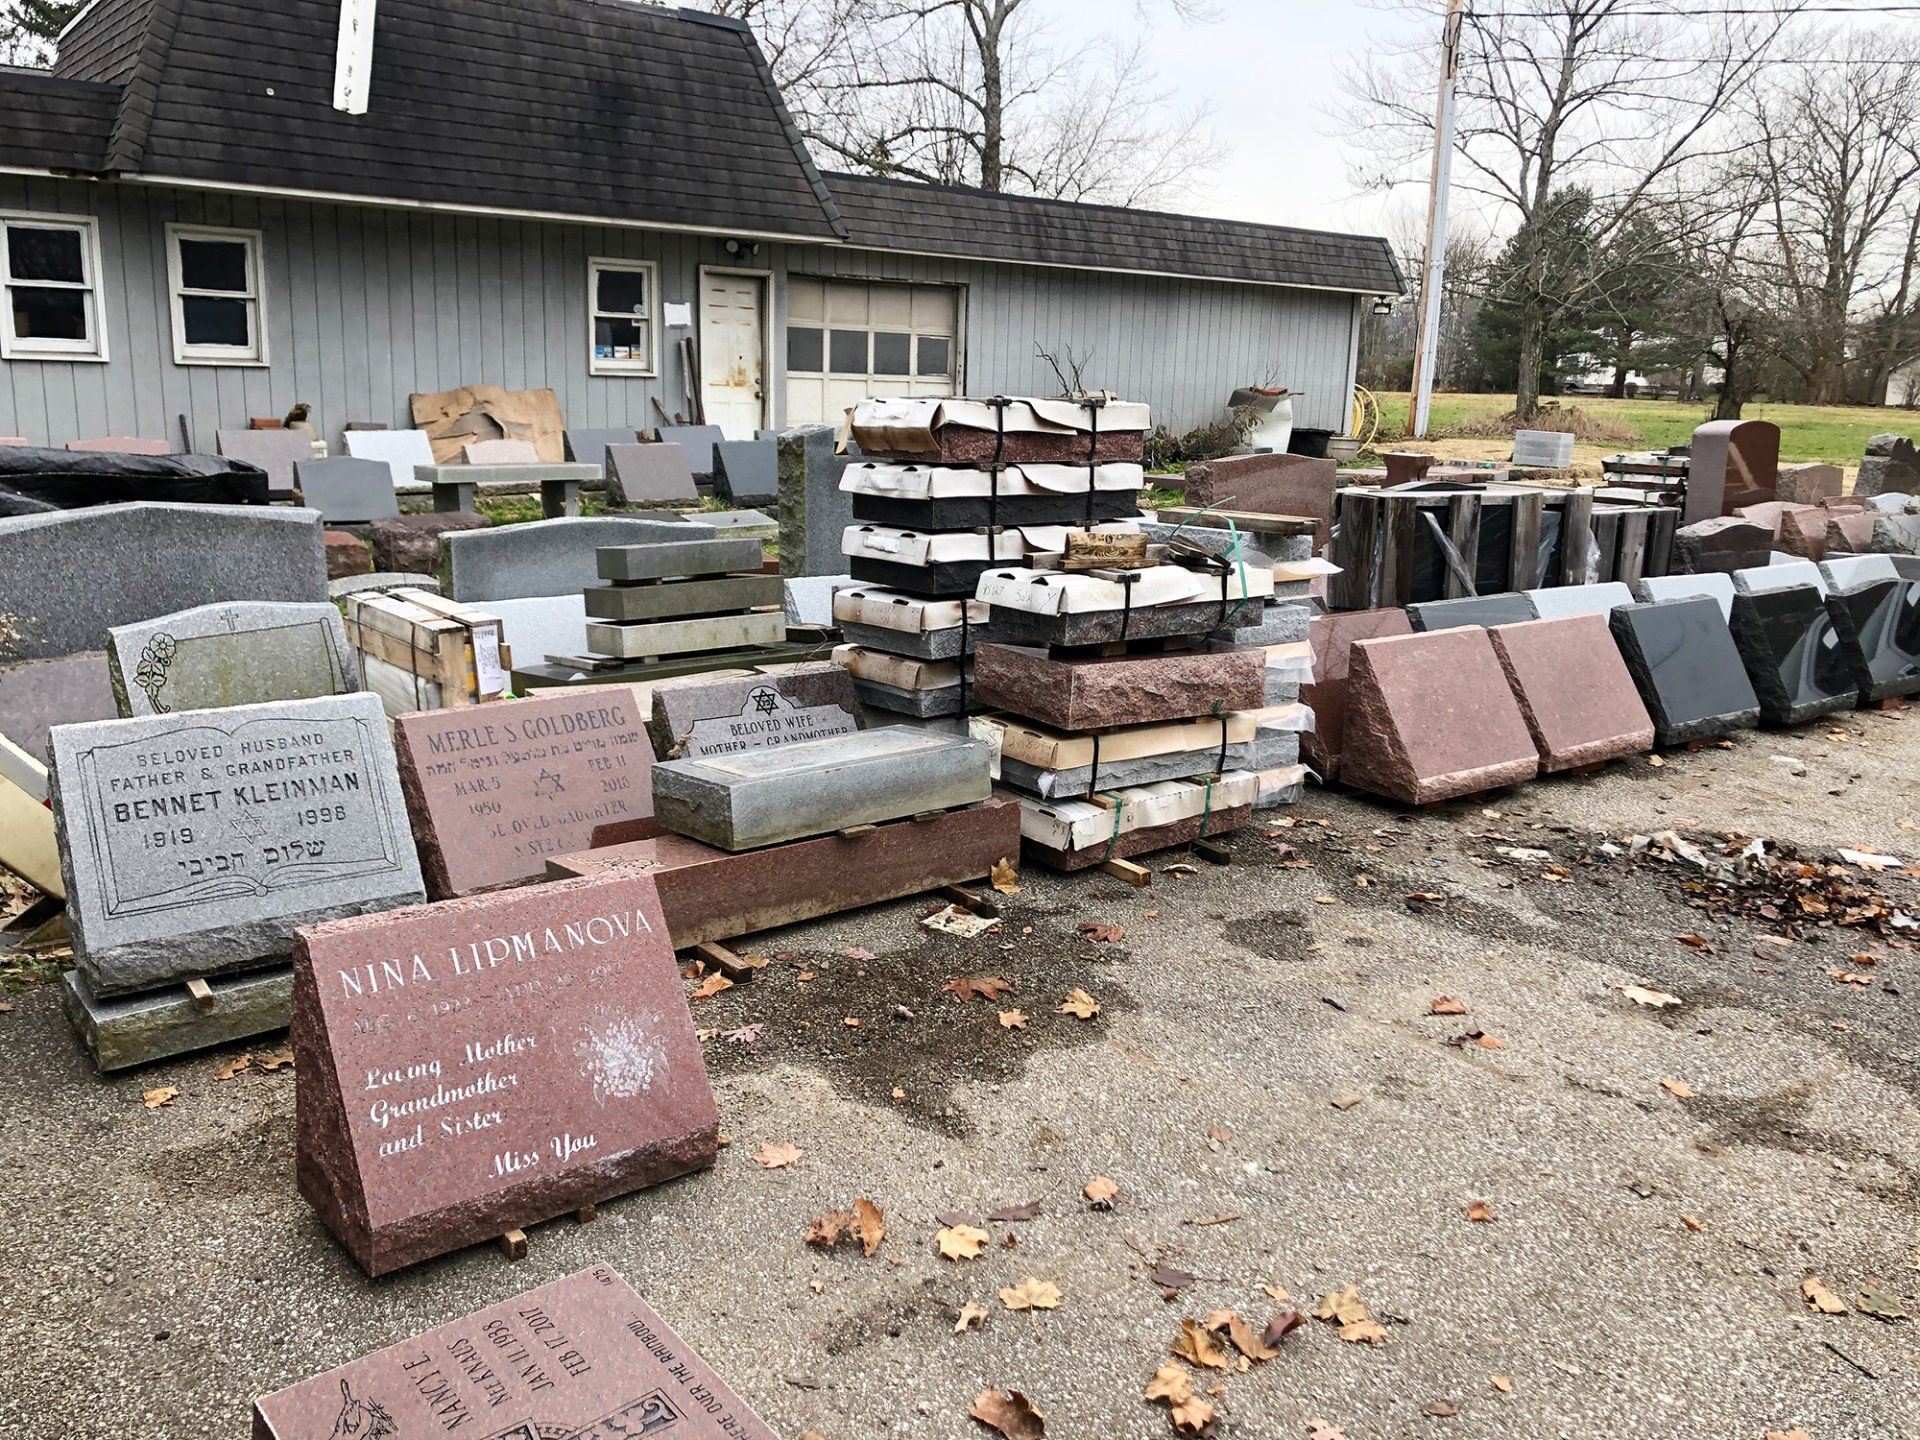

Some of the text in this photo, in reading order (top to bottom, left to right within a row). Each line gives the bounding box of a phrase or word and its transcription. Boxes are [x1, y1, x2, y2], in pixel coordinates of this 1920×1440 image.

[427, 725, 499, 754] MERLE
[522, 706, 626, 739] GOLDBERG
[730, 714, 814, 737] BELOVED WIFE
[111, 749, 354, 792] FATHER & GRANDFATHER
[137, 733, 323, 767] BELOVED HUSBAND
[114, 772, 360, 822] BENNET KLEINMAN
[142, 805, 346, 849] 1919 1998
[263, 840, 326, 865] שלום
[337, 908, 653, 998] NINA LIPMANOVA
[365, 1033, 537, 1090] Loving Mother
[370, 1071, 518, 1129] Grandmother
[379, 1109, 502, 1157] and Sister
[488, 1132, 598, 1179] Miss You
[592, 1268, 615, 1288] 1475
[482, 1320, 518, 1348] 1938
[519, 1307, 555, 1334] 2017
[446, 1338, 495, 1385] KNAUS
[668, 1362, 695, 1385] THE
[403, 1350, 474, 1431] NANCY E.
[689, 1384, 723, 1414] OVER
